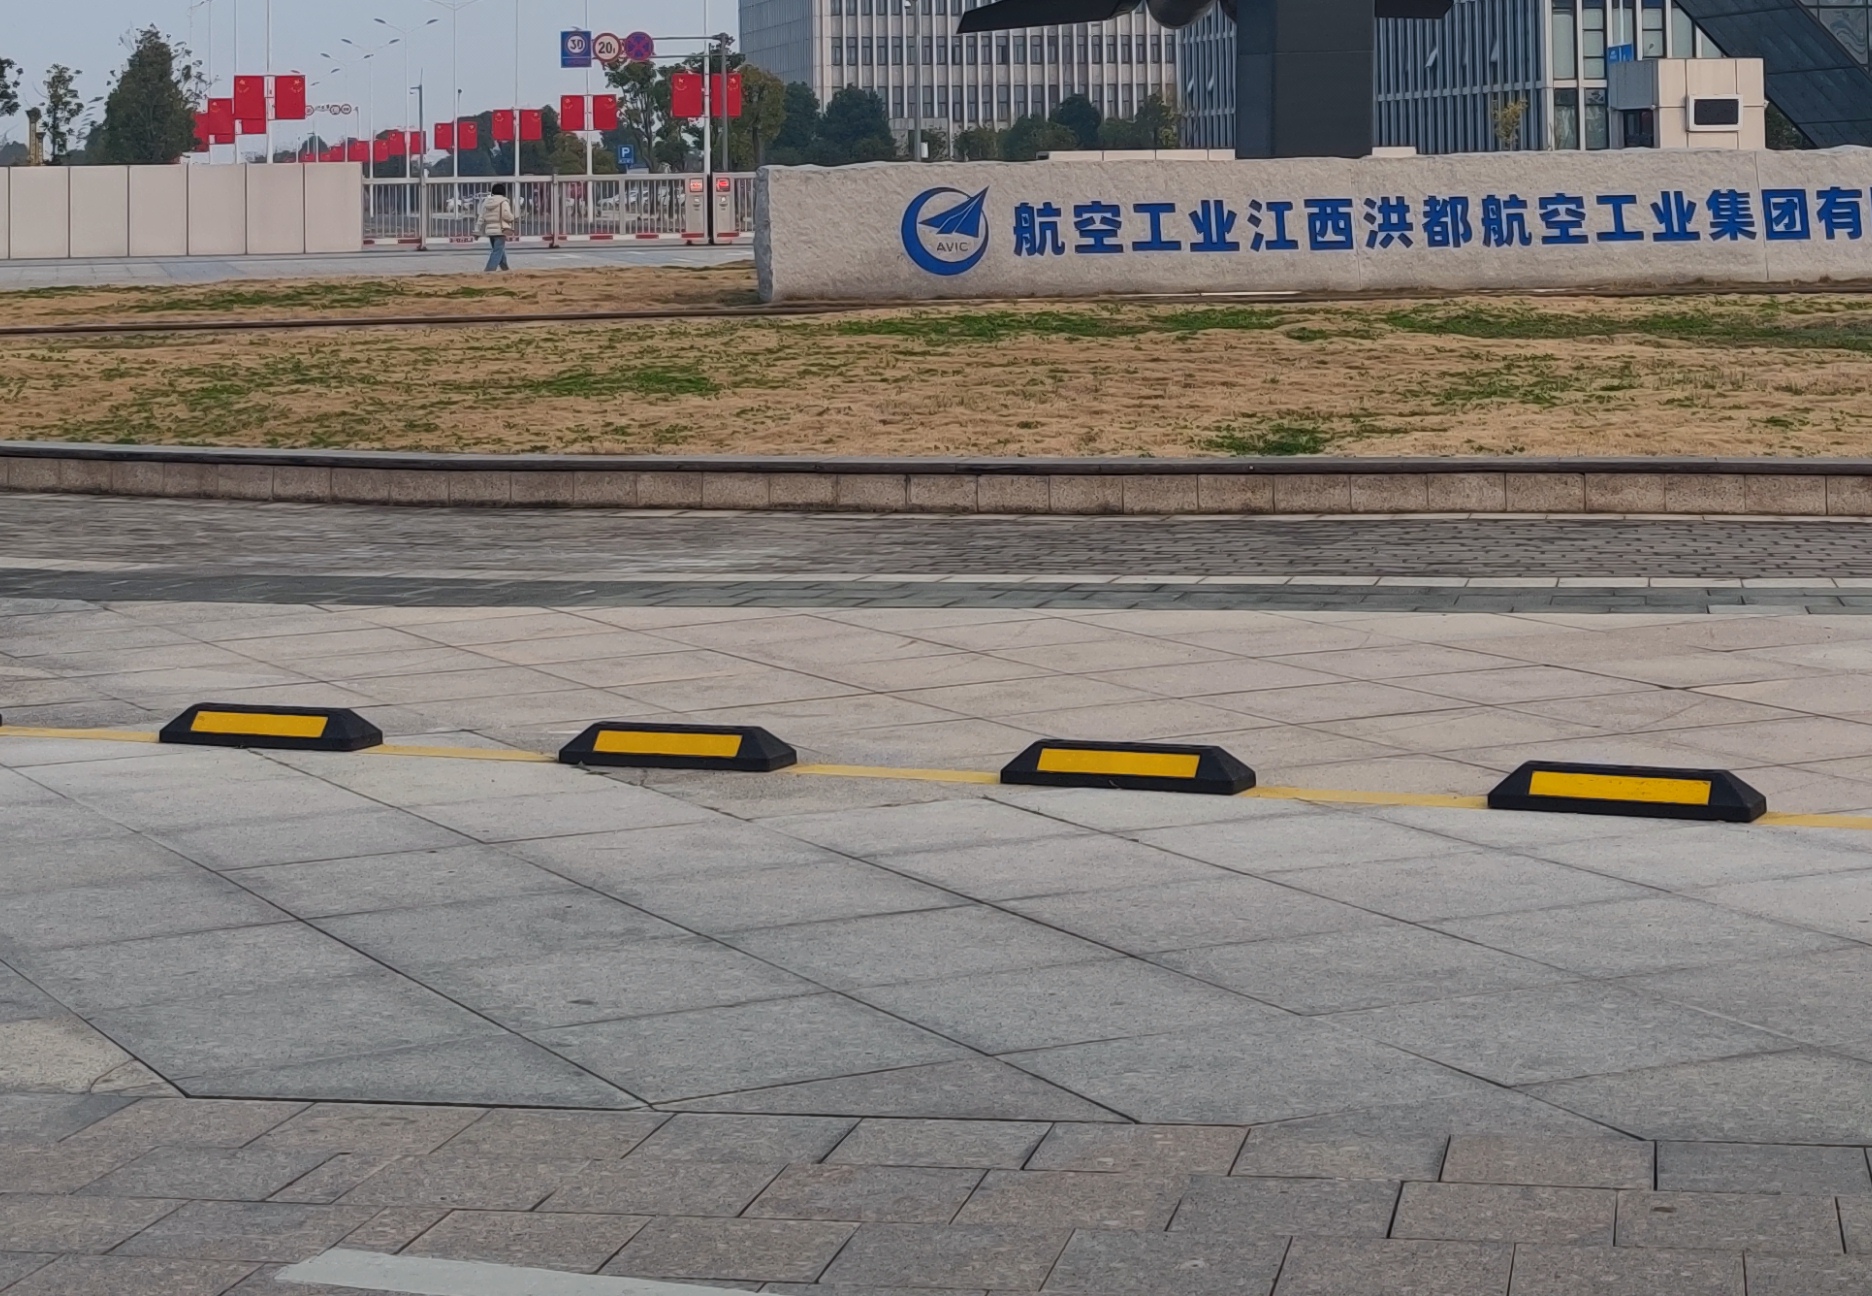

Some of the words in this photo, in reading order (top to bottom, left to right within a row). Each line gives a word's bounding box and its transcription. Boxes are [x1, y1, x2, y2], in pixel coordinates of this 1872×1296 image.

[570, 39, 584, 51] 30
[621, 147, 630, 158] P
[937, 241, 969, 252] AVIC
